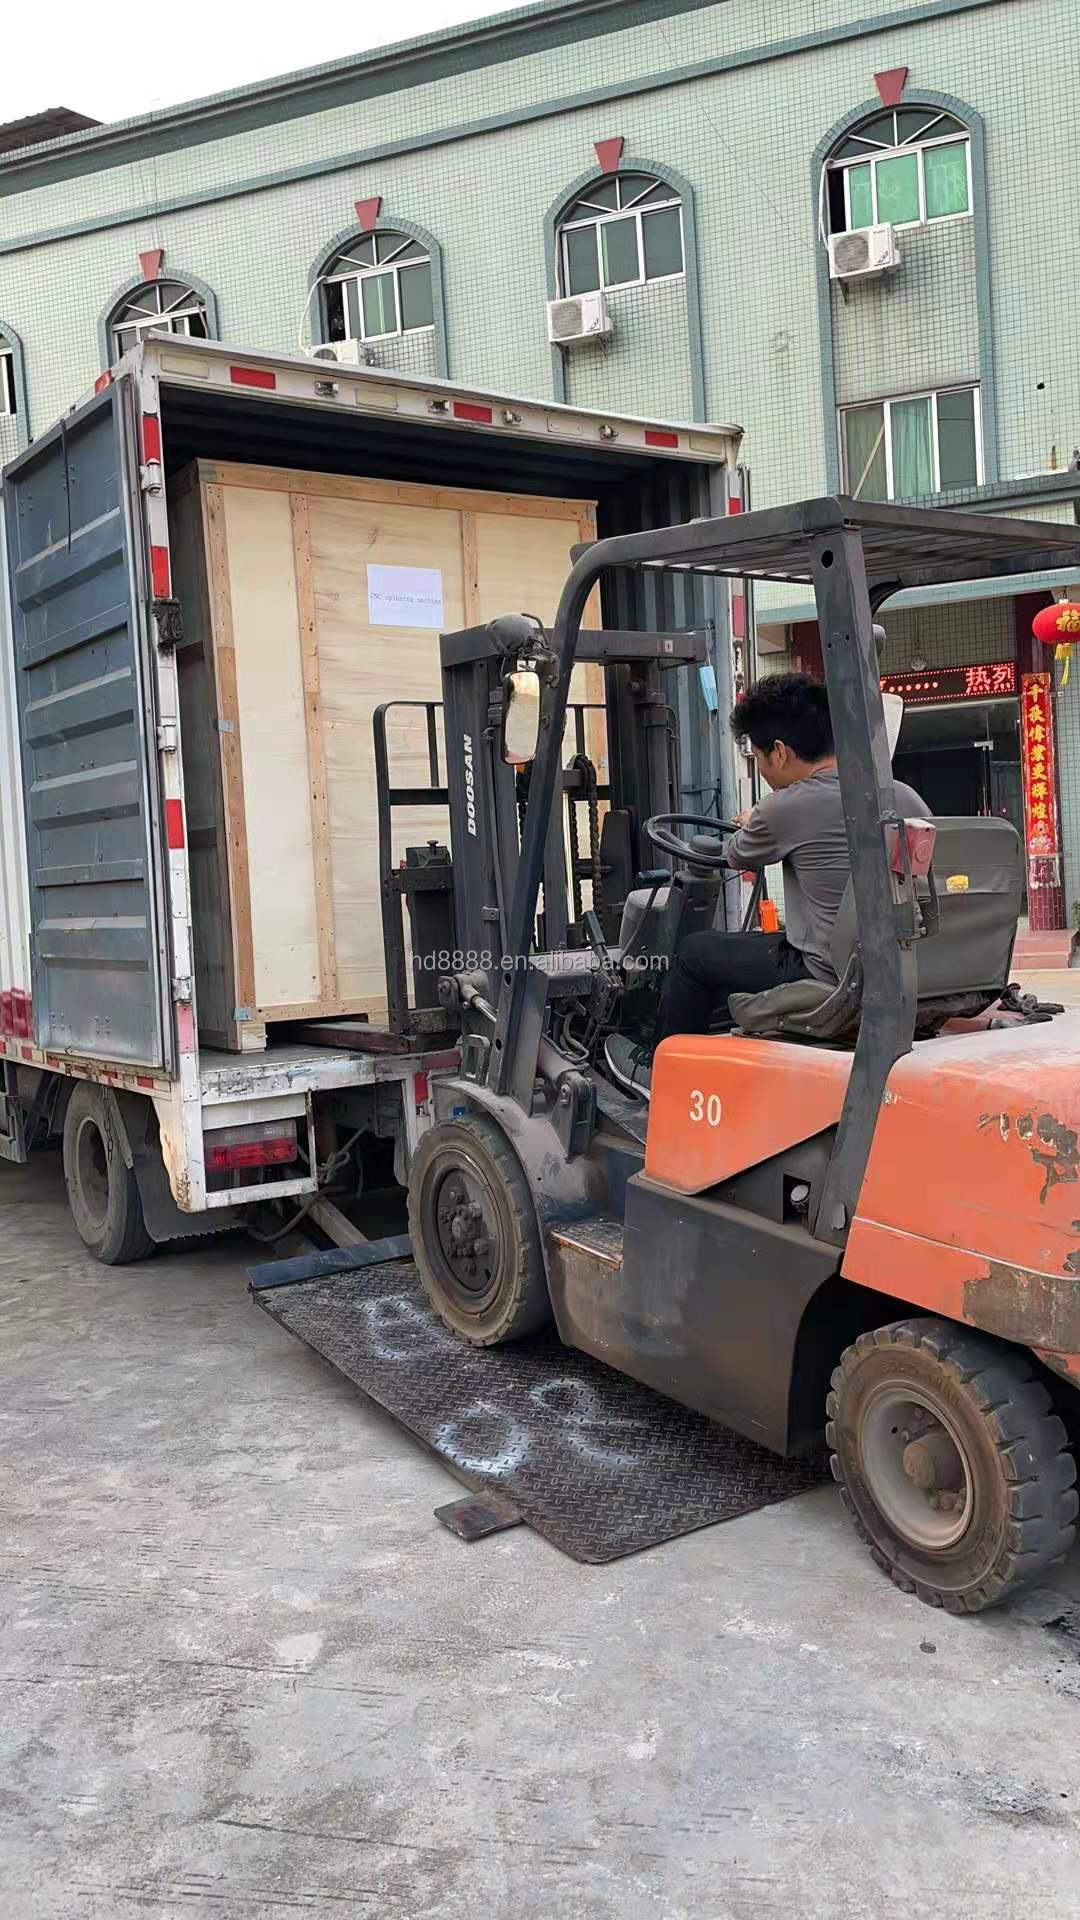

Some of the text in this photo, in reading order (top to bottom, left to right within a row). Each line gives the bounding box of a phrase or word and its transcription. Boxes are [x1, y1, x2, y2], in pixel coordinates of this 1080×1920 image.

[965, 665, 1011, 693] 热烈
[463, 733, 477, 836] DOOSAN
[689, 1089, 721, 1126] 30
